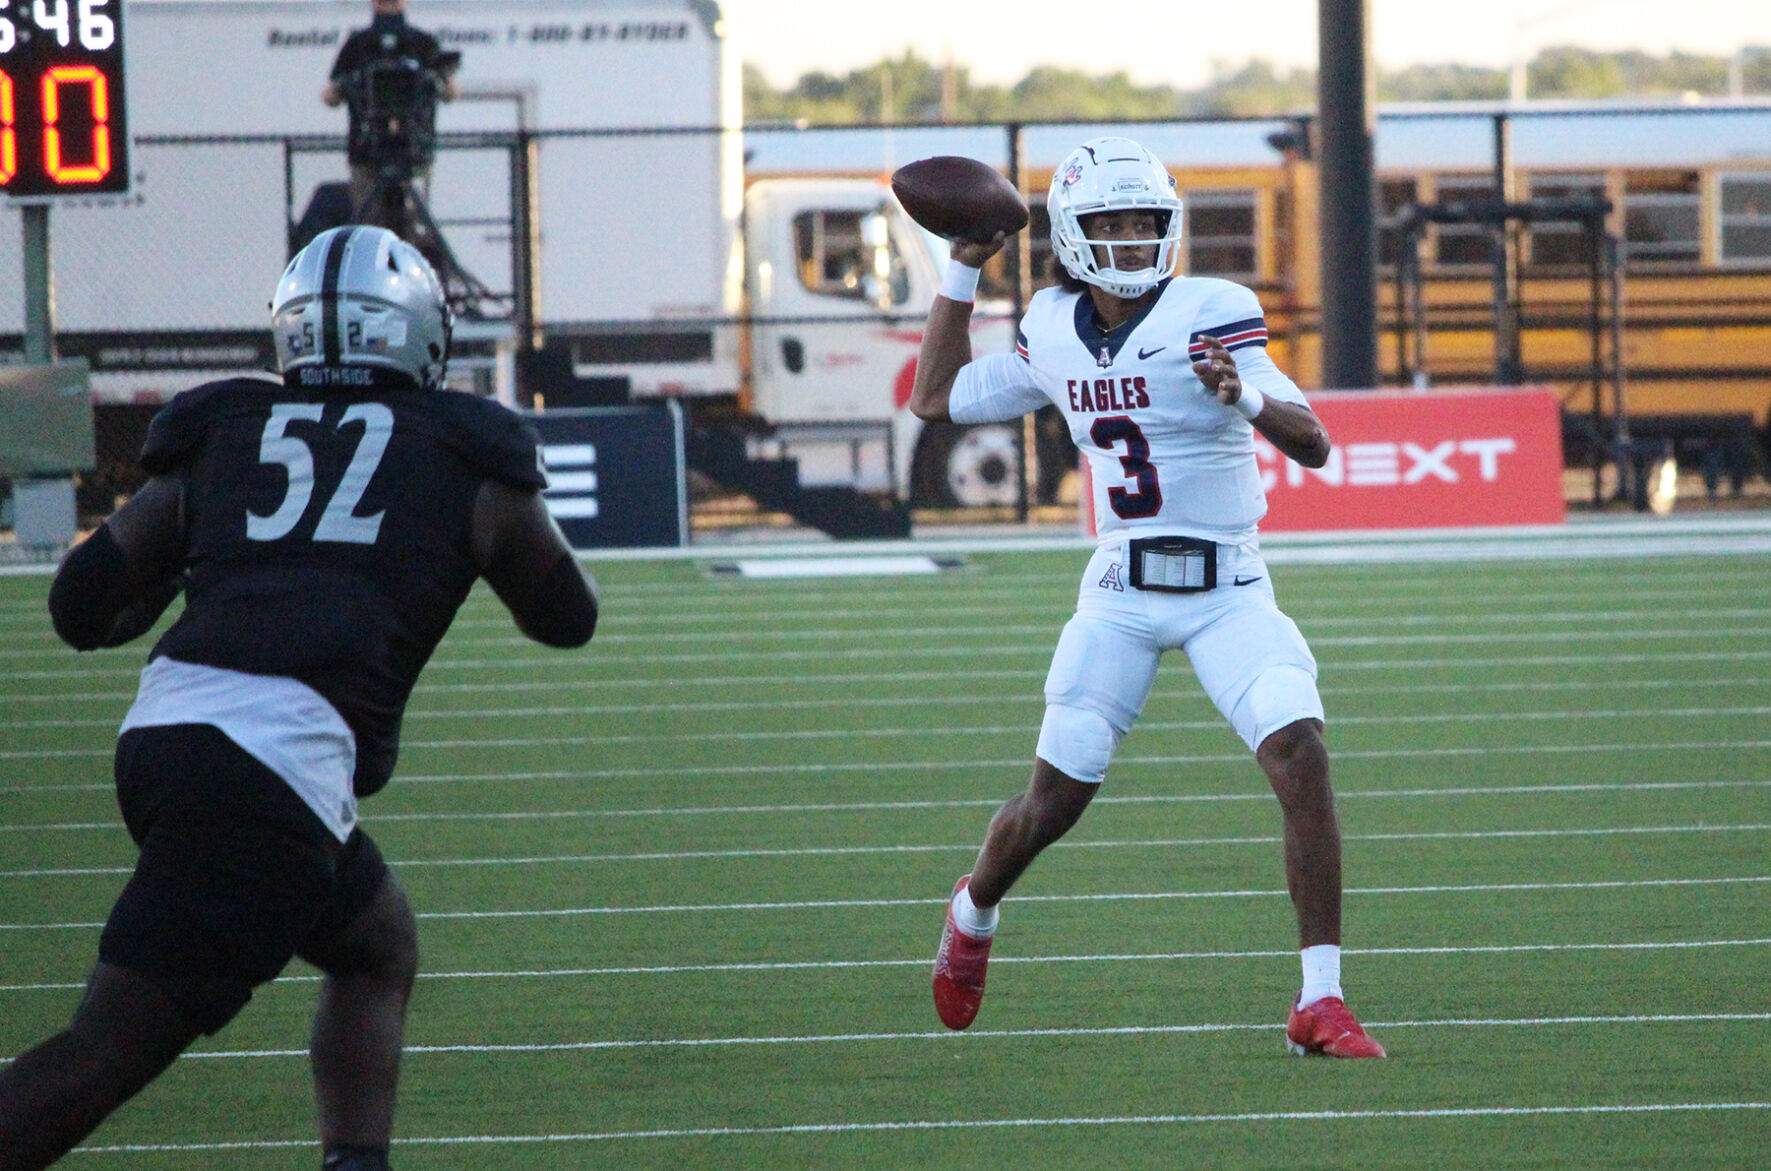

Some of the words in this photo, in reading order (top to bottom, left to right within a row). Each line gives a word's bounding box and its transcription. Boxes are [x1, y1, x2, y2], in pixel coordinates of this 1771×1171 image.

[300, 366, 374, 386] SOUTHSIDE
[1067, 376, 1150, 412] EAGLES
[246, 402, 394, 545] 52
[1090, 415, 1163, 520] 3
